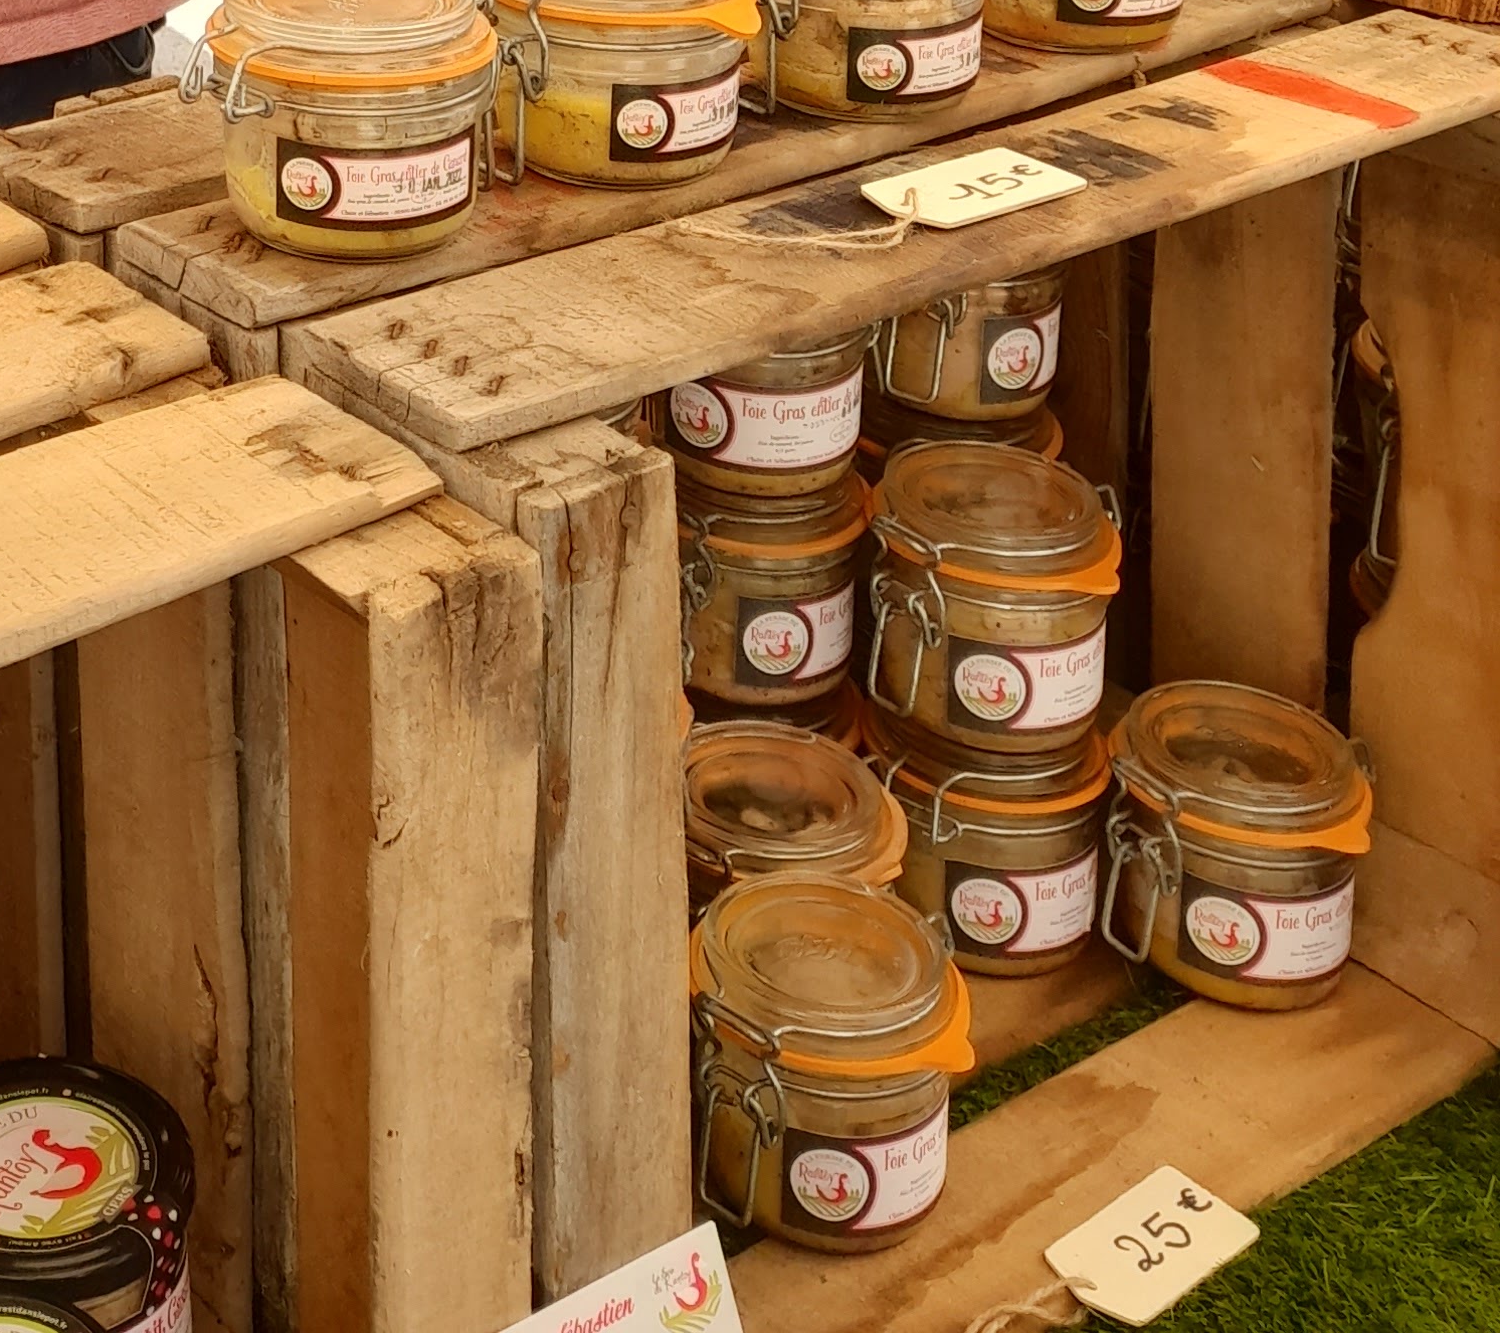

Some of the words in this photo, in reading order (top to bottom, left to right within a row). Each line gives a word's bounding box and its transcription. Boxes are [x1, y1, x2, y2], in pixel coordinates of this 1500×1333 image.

[346, 166, 365, 183] Foie
[371, 166, 397, 186] Gras
[742, 397, 767, 419] Foie
[773, 400, 806, 424] Gras
[811, 396, 842, 417] entier
[1040, 658, 1062, 678] Foie
[1067, 652, 1090, 676] Gras
[1036, 881, 1057, 901] Foie
[1062, 873, 1086, 899] Gras
[1276, 909, 1300, 930] Foie
[1306, 906, 1332, 931] Gras
[7, 1106, 39, 1124] DU
[884, 1148, 908, 1171] Foie
[913, 1136, 936, 1164] Gras
